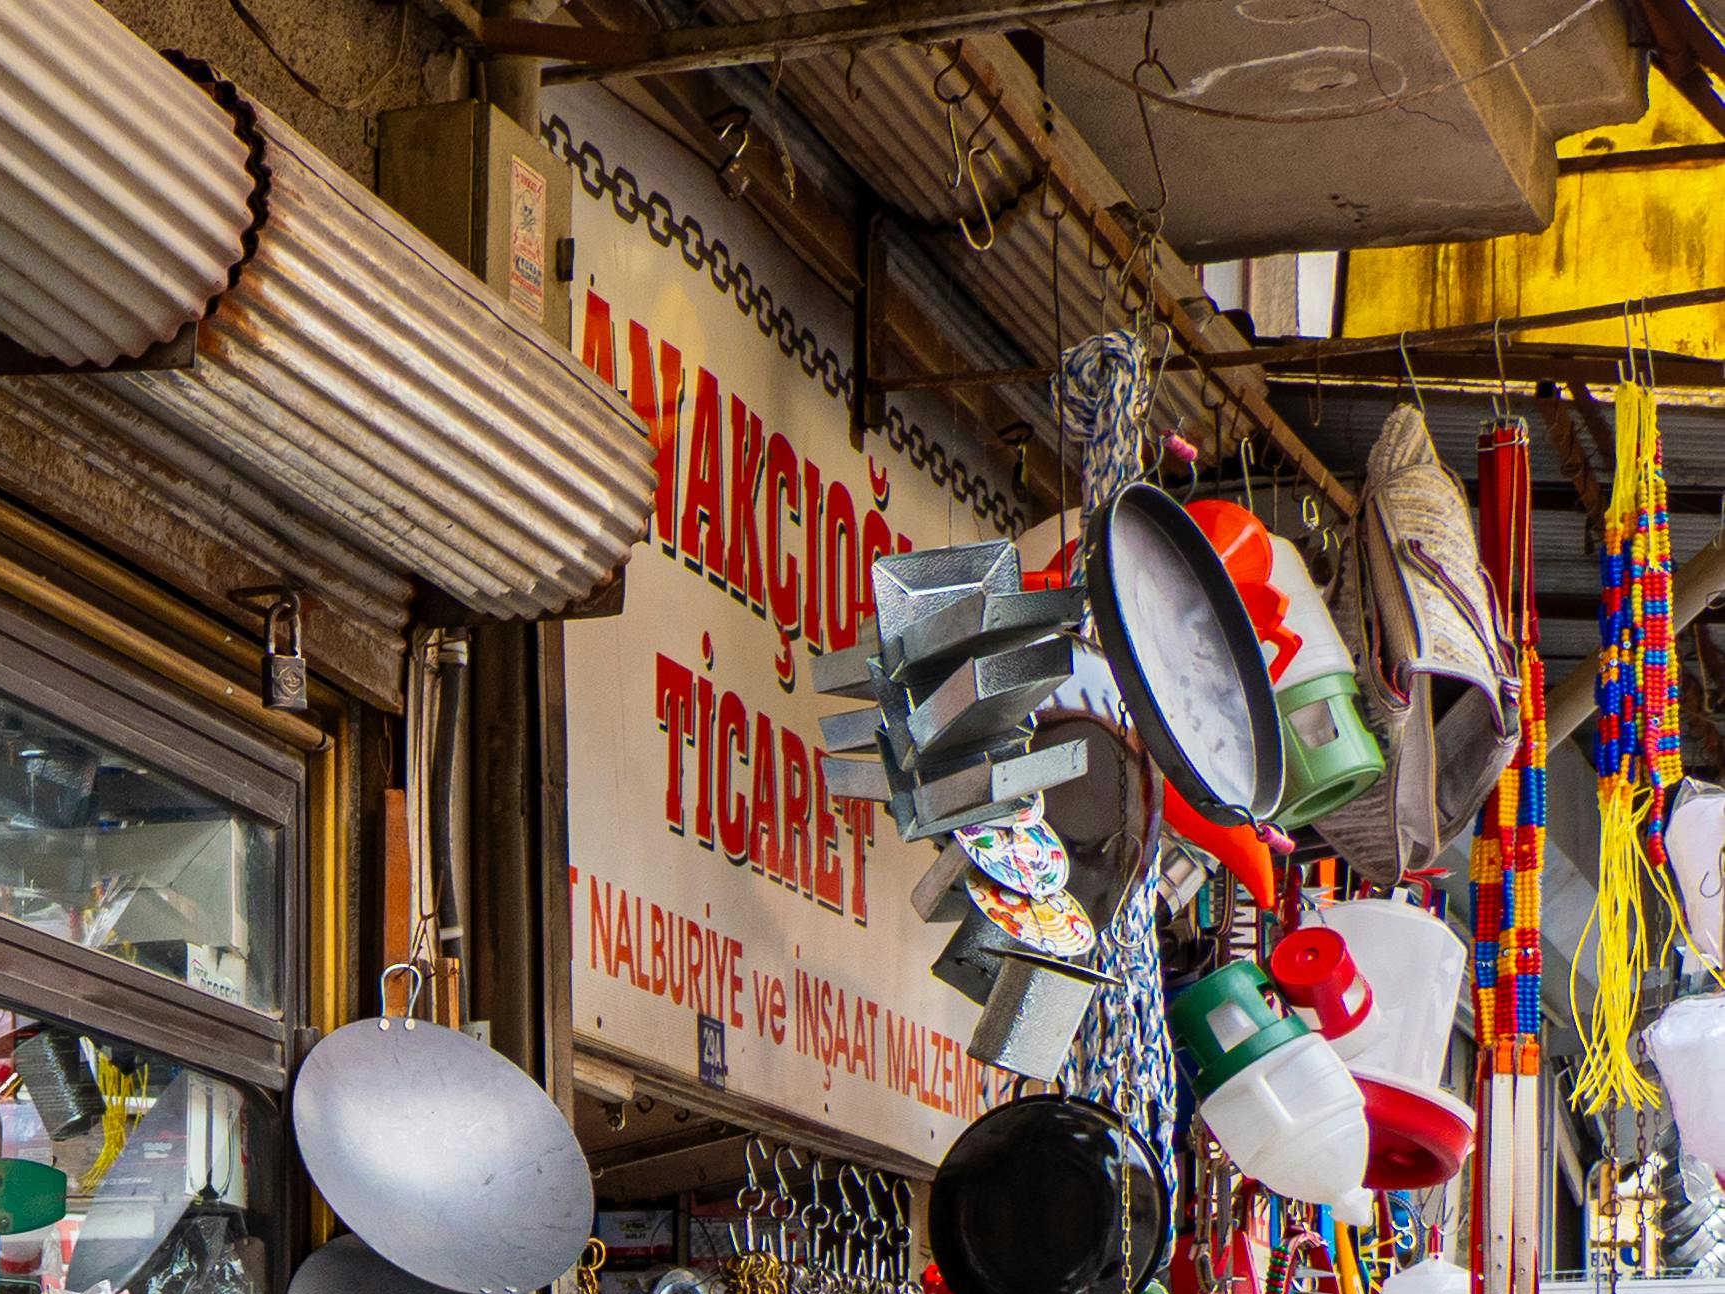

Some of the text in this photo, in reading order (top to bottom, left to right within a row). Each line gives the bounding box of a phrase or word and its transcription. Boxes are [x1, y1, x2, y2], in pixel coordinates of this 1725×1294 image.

[655, 631, 873, 924] TİCARET
[590, 875, 743, 1029] NALBURİYE
[753, 970, 787, 1045] ve
[795, 945, 879, 1091] İNŞAAT
